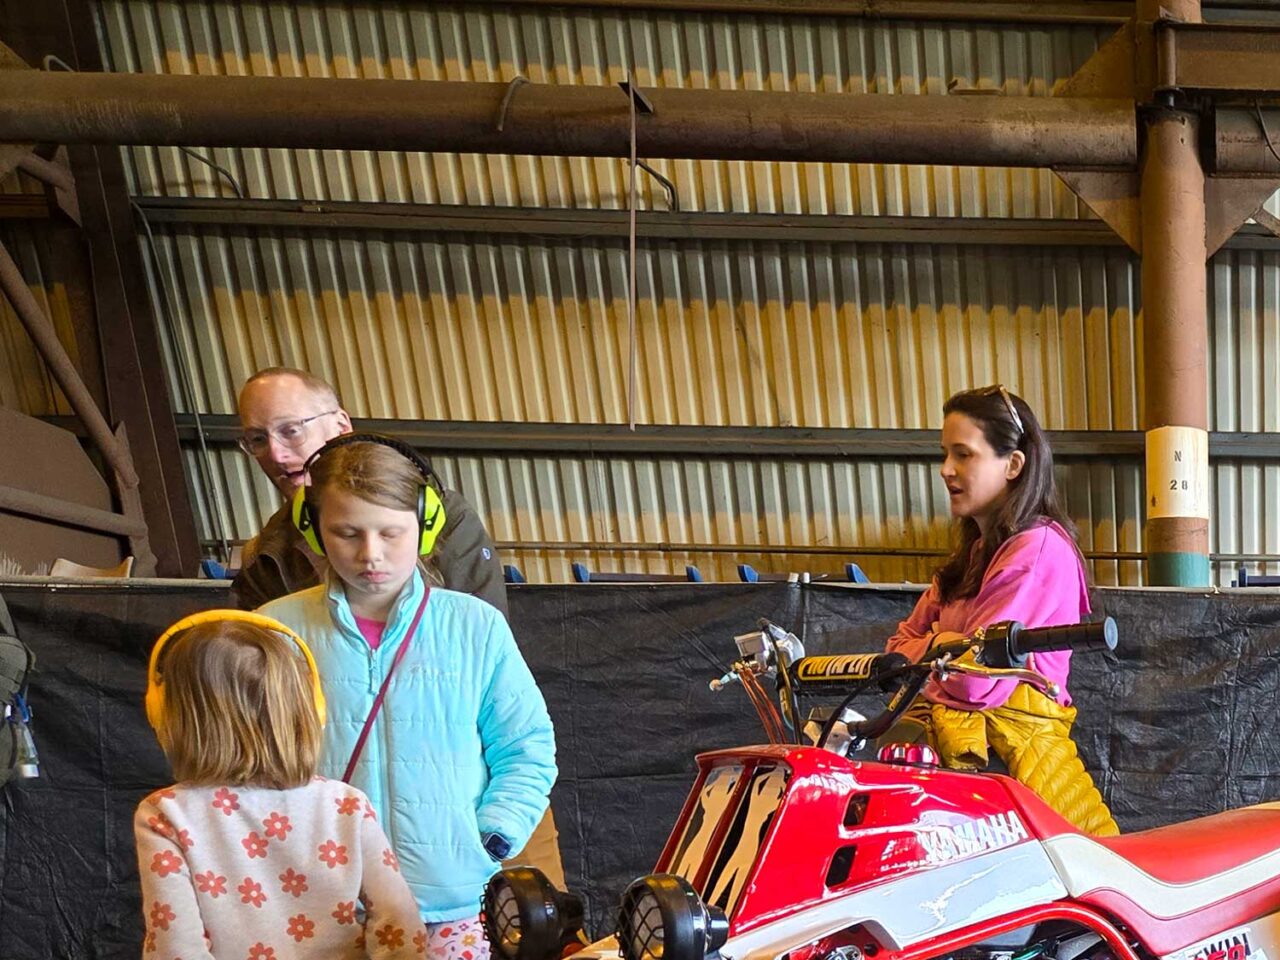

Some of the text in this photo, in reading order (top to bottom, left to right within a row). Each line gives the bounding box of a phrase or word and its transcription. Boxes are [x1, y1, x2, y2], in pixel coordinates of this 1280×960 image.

[1174, 450, 1182, 462] N
[1170, 480, 1188, 490] 28
[923, 810, 1028, 860] YAMAHA
